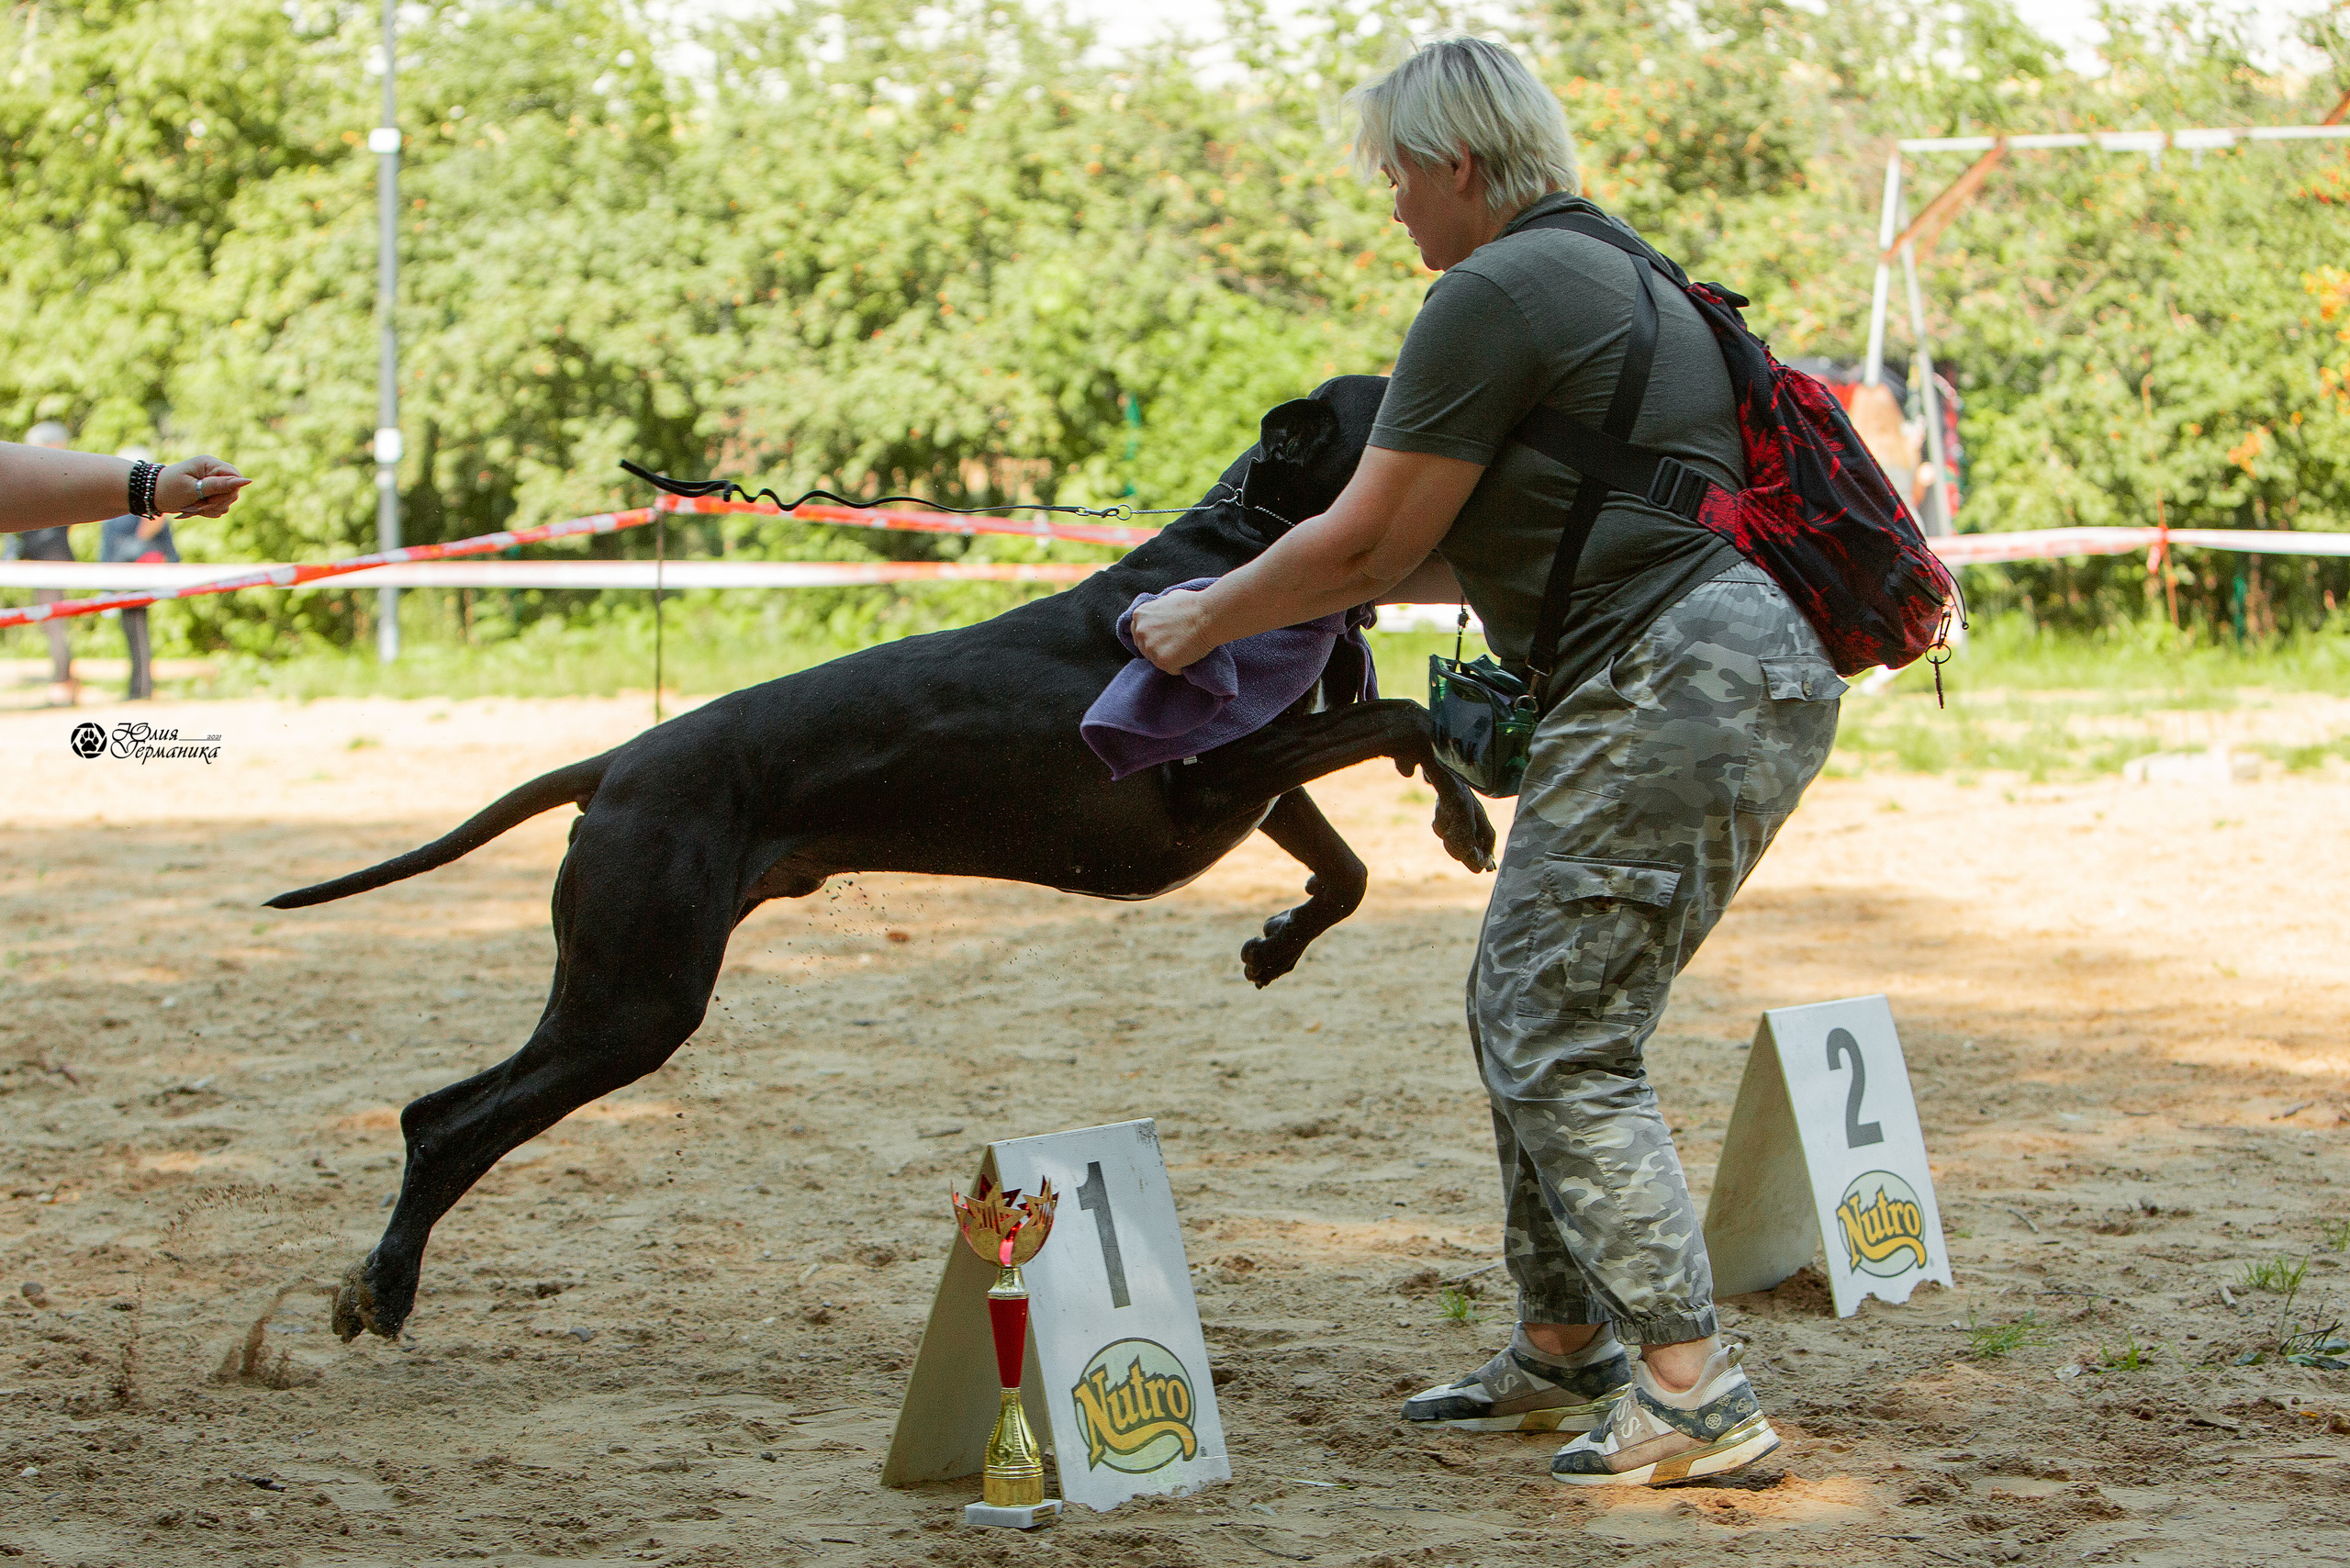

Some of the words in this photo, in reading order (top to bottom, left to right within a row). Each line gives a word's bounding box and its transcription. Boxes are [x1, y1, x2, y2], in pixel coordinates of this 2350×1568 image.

[1826, 1026, 1884, 1148] 2
[1076, 1160, 1131, 1309] 1
[1836, 1184, 1927, 1275] Nutro
[1071, 1354, 1197, 1472] Nutro
